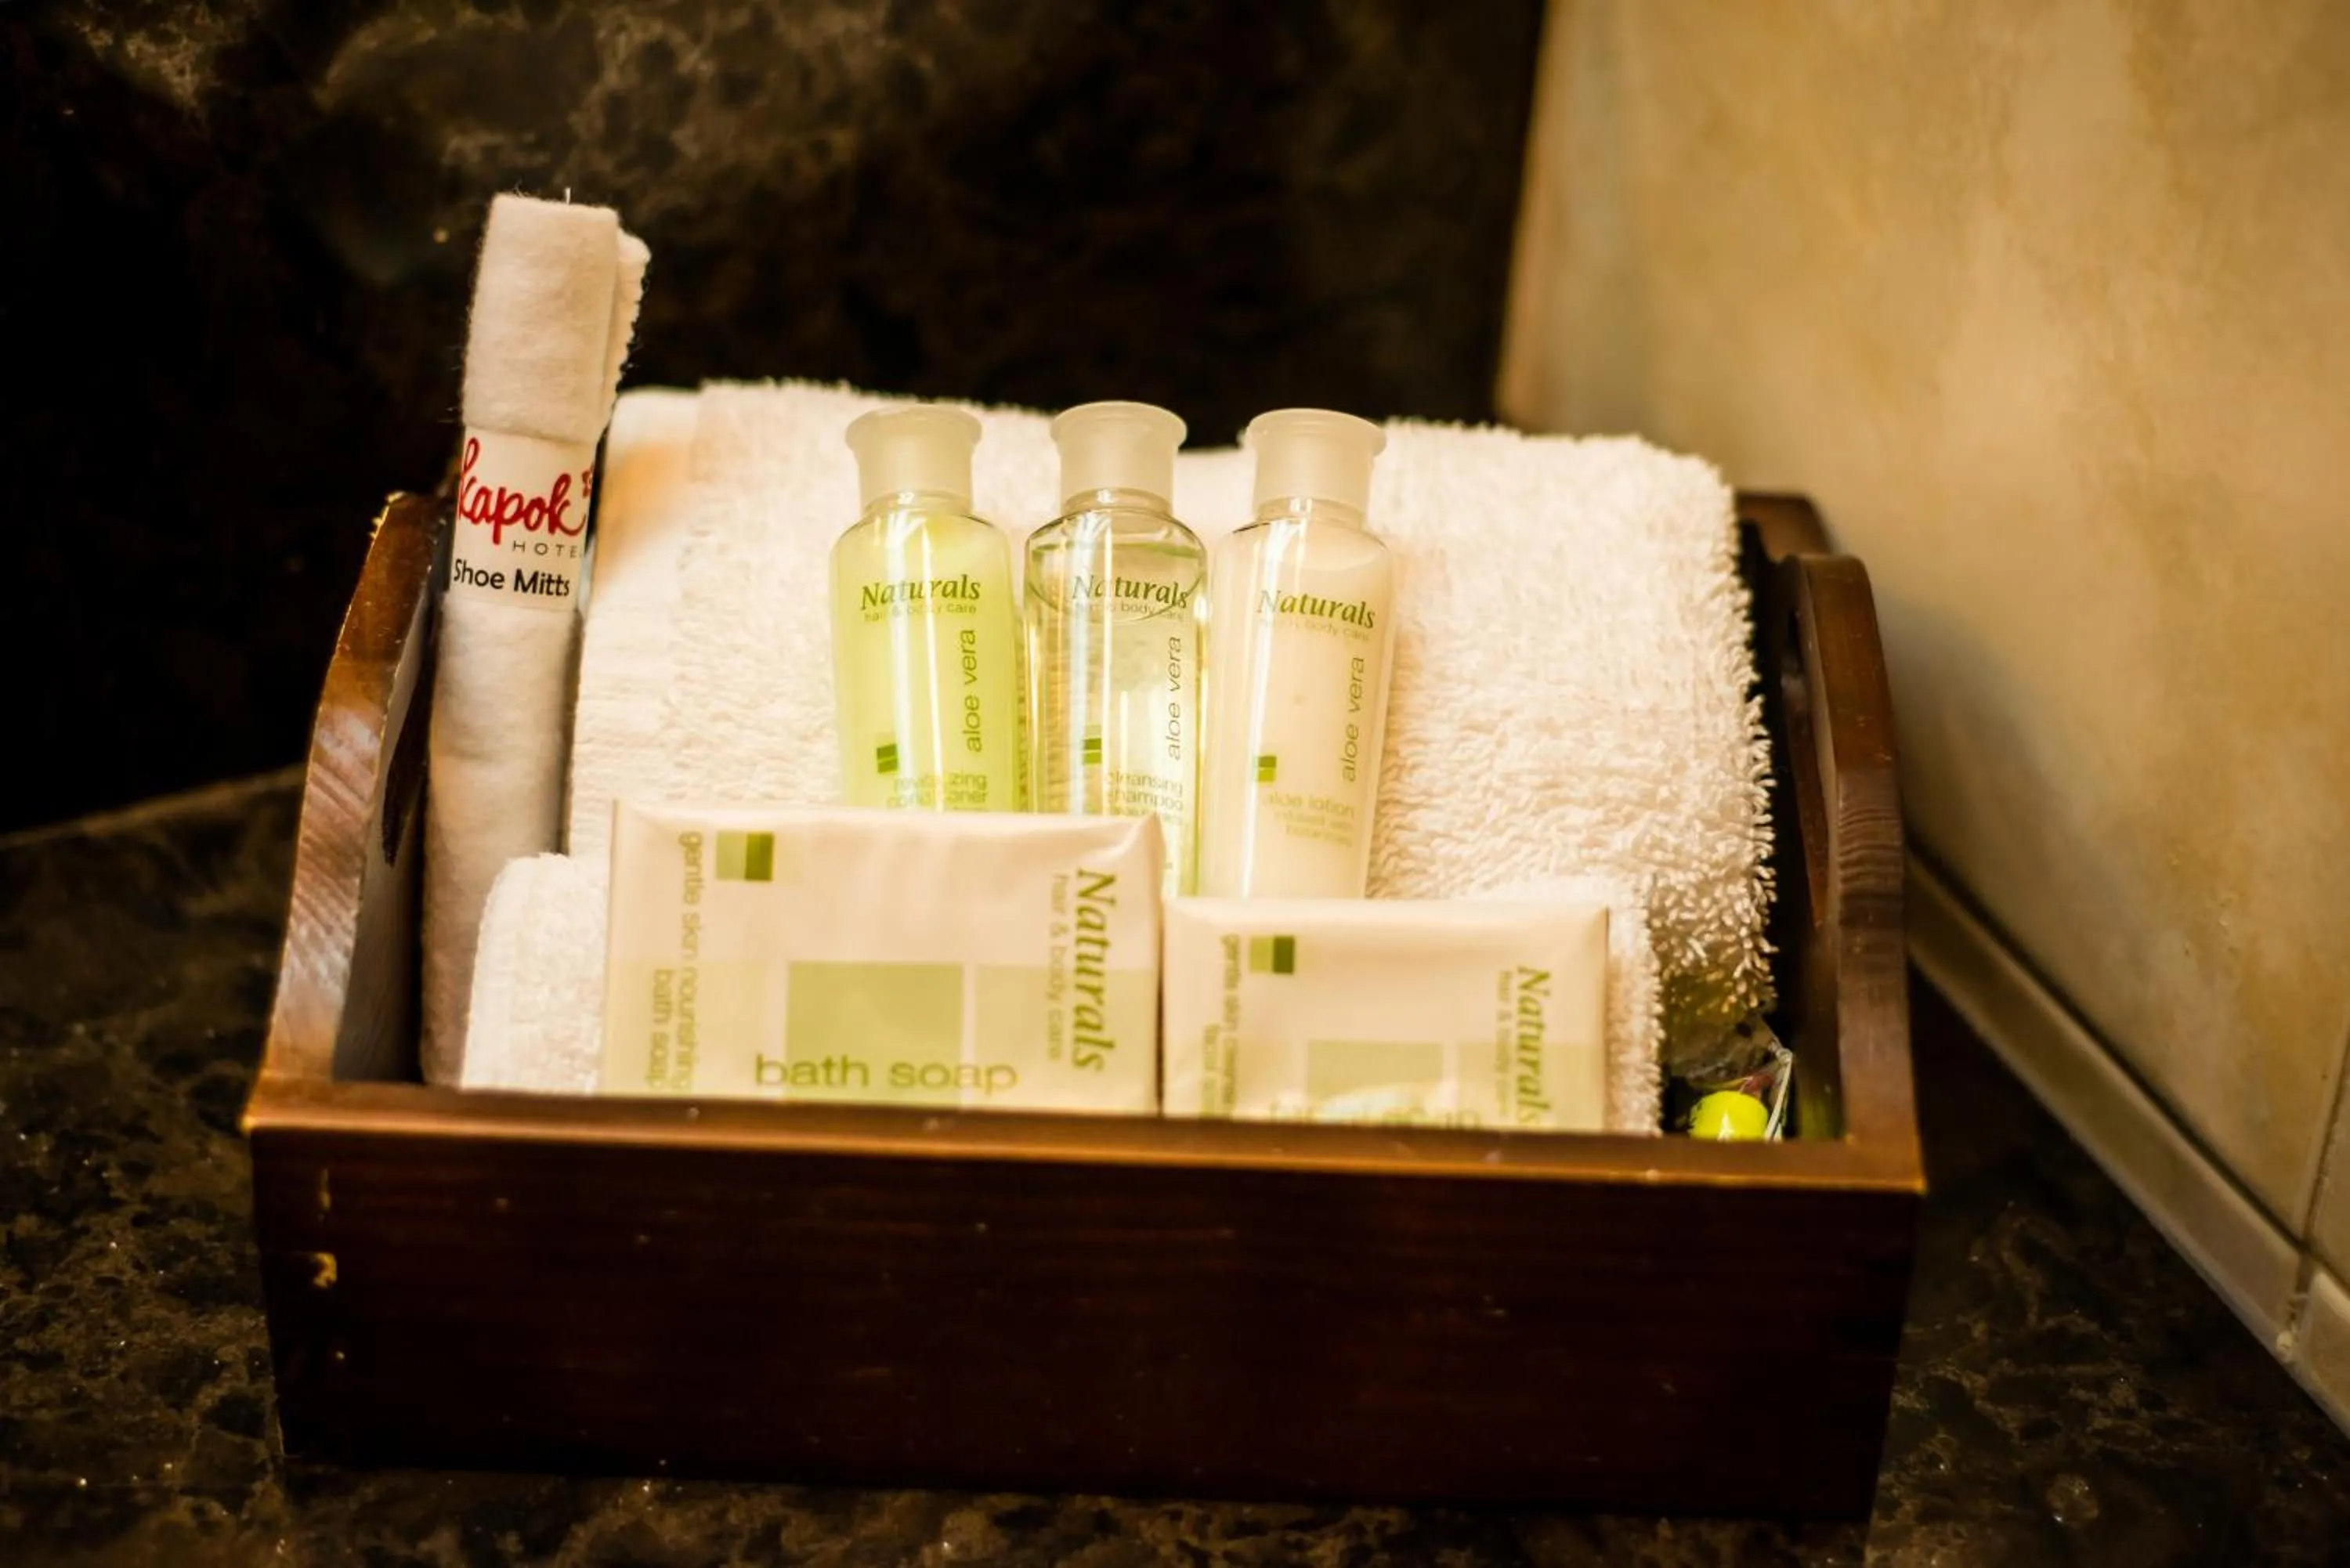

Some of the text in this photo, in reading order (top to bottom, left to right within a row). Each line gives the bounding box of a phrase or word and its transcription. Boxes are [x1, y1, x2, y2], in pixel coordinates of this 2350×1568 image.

[512, 540, 582, 558] HOTE
[454, 558, 569, 596] Shoe Mitts
[861, 574, 981, 610] Naturals
[1072, 575, 1188, 609] Naturals
[1256, 590, 1375, 628] Naturals
[960, 630, 982, 752] aloe vera
[1166, 636, 1182, 761] aloe vera
[1340, 657, 1365, 783] aloe vera
[678, 831, 705, 905] gentle
[681, 912, 702, 960] skin
[1072, 867, 1117, 1072] Naturals
[653, 968, 675, 1026] bath
[1517, 966, 1551, 1125] Naturals
[755, 1053, 1019, 1097] bath soap
